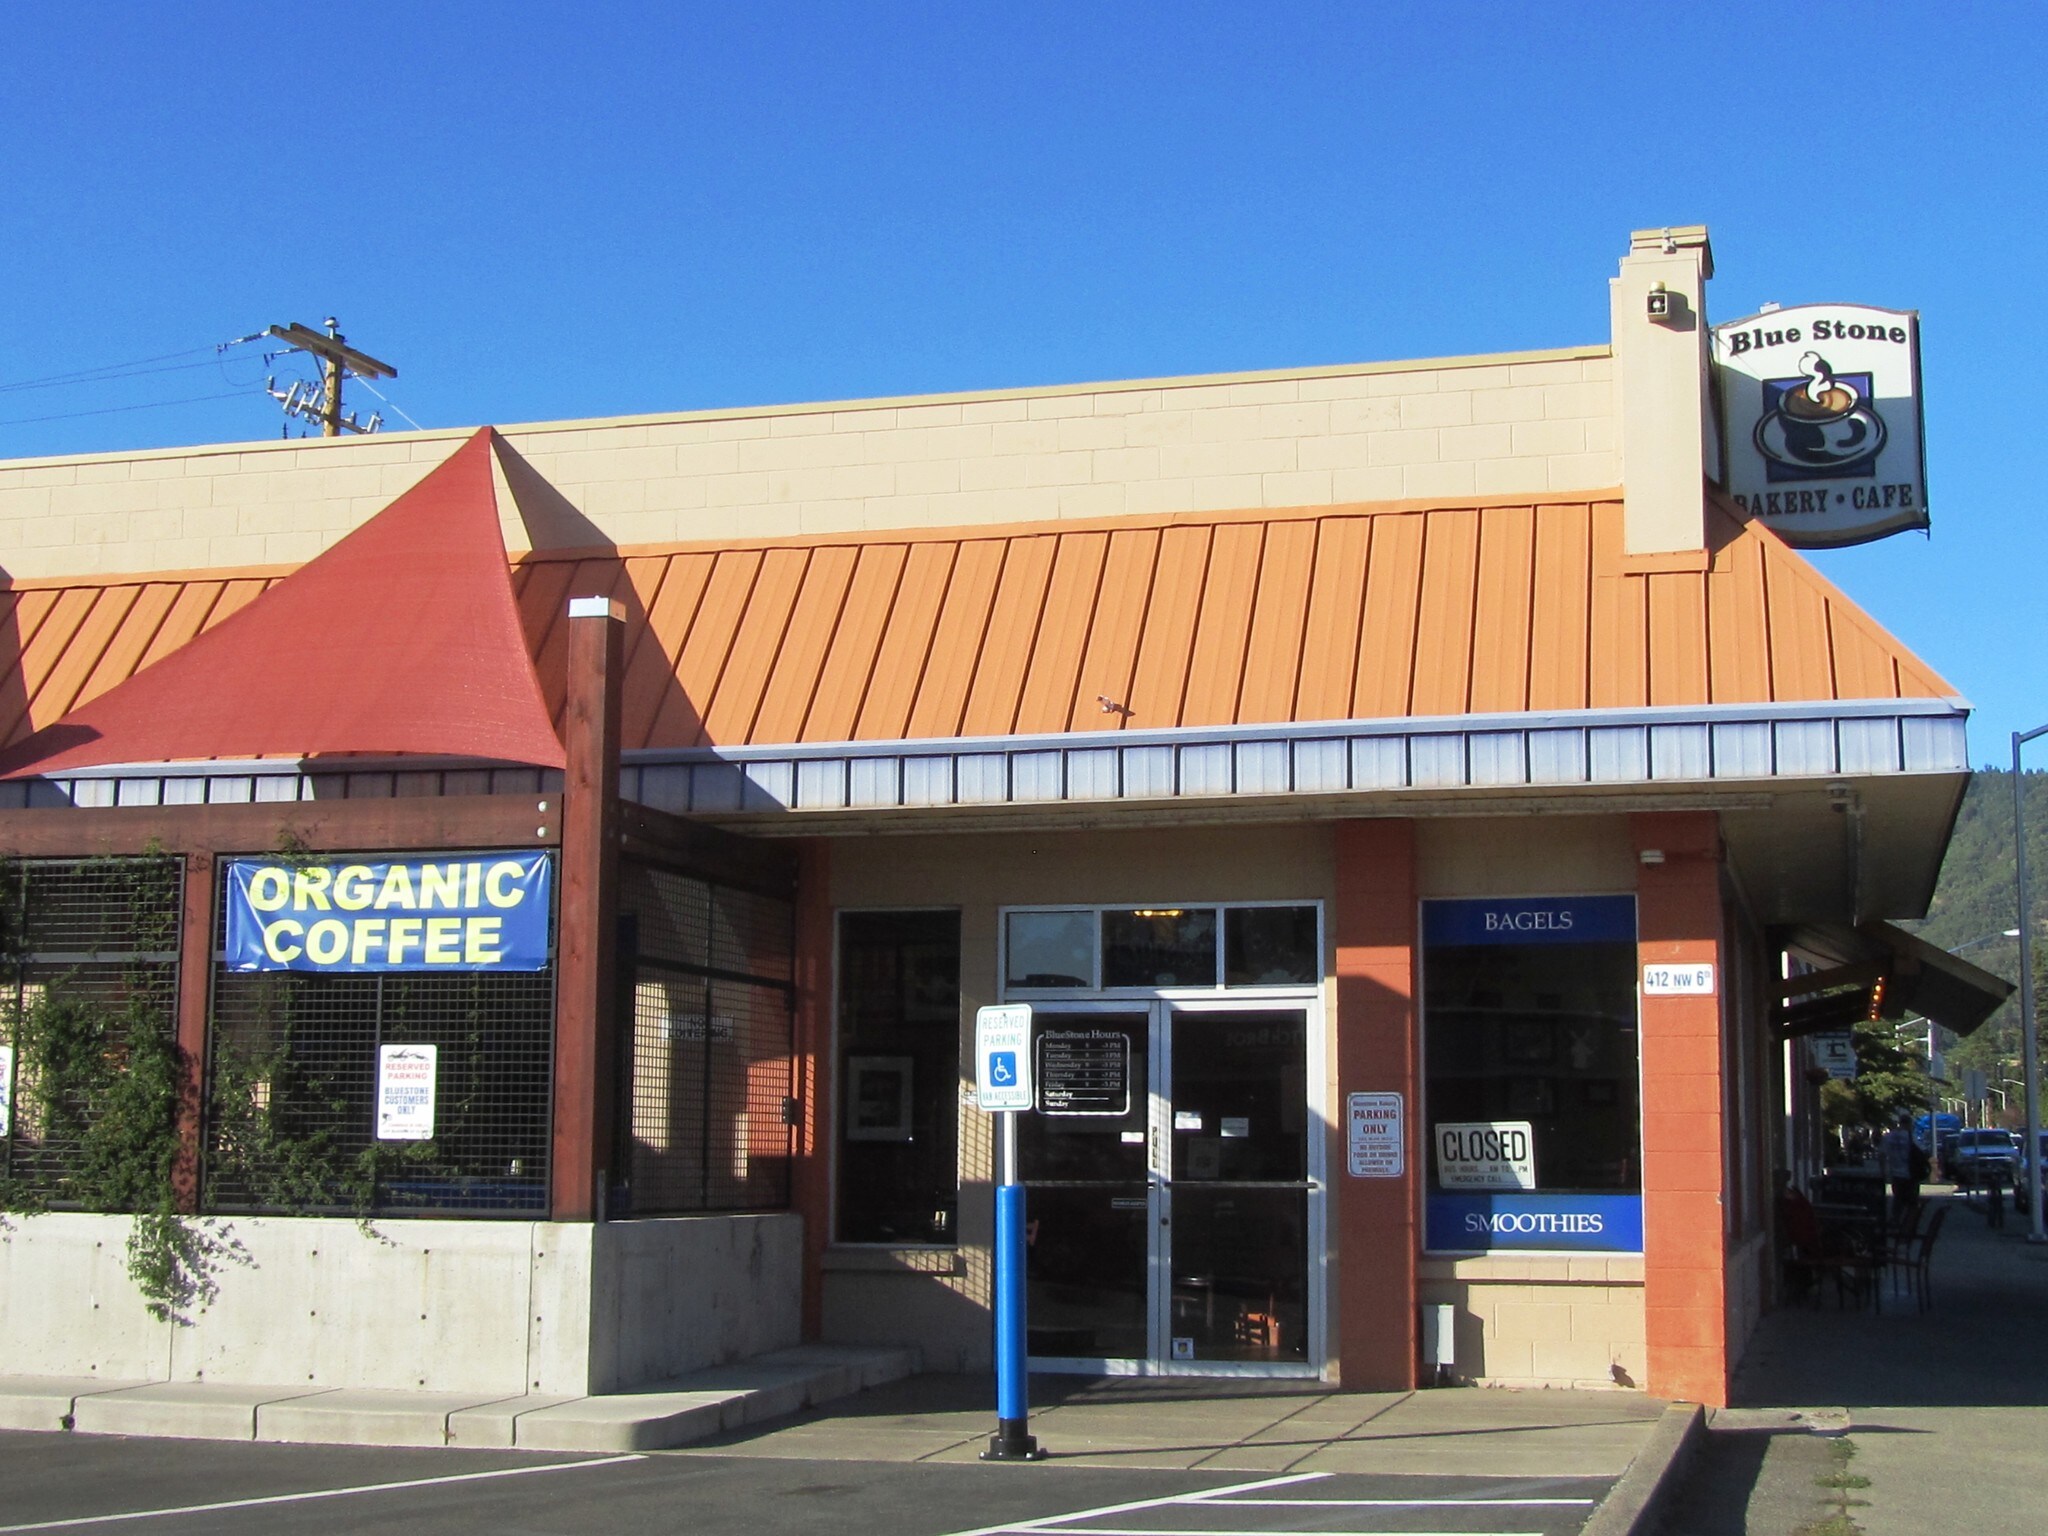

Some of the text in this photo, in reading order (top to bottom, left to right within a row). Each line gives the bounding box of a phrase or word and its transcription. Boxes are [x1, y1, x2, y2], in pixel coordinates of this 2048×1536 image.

[1729, 319, 1907, 357] Blue Stone
[1852, 483, 1912, 510] CAFE
[249, 861, 525, 912] ORGANIC
[1485, 911, 1573, 931] BAGELS
[262, 916, 502, 965] COFFEE
[1646, 971, 1669, 987] 412
[1673, 973, 1692, 987] NW
[982, 1015, 1025, 1029] RESERVED
[983, 1033, 1022, 1047] PARKING
[1091, 1029, 1120, 1039] Hours
[1045, 1042, 1071, 1050] Monday
[384, 1095, 429, 1105] CUSTOMERS
[982, 1092, 993, 1101] VAN
[994, 1091, 1027, 1101] ACCESSIBLE
[1045, 1090, 1073, 1098] Saturday
[397, 1106, 416, 1114] ONLY
[1045, 1100, 1069, 1108] Sunday
[1353, 1109, 1397, 1120] PARKING
[1362, 1123, 1388, 1134] ONLY
[1442, 1130, 1527, 1162] CLOSED
[1464, 1213, 1603, 1233] SMOOTHIES
